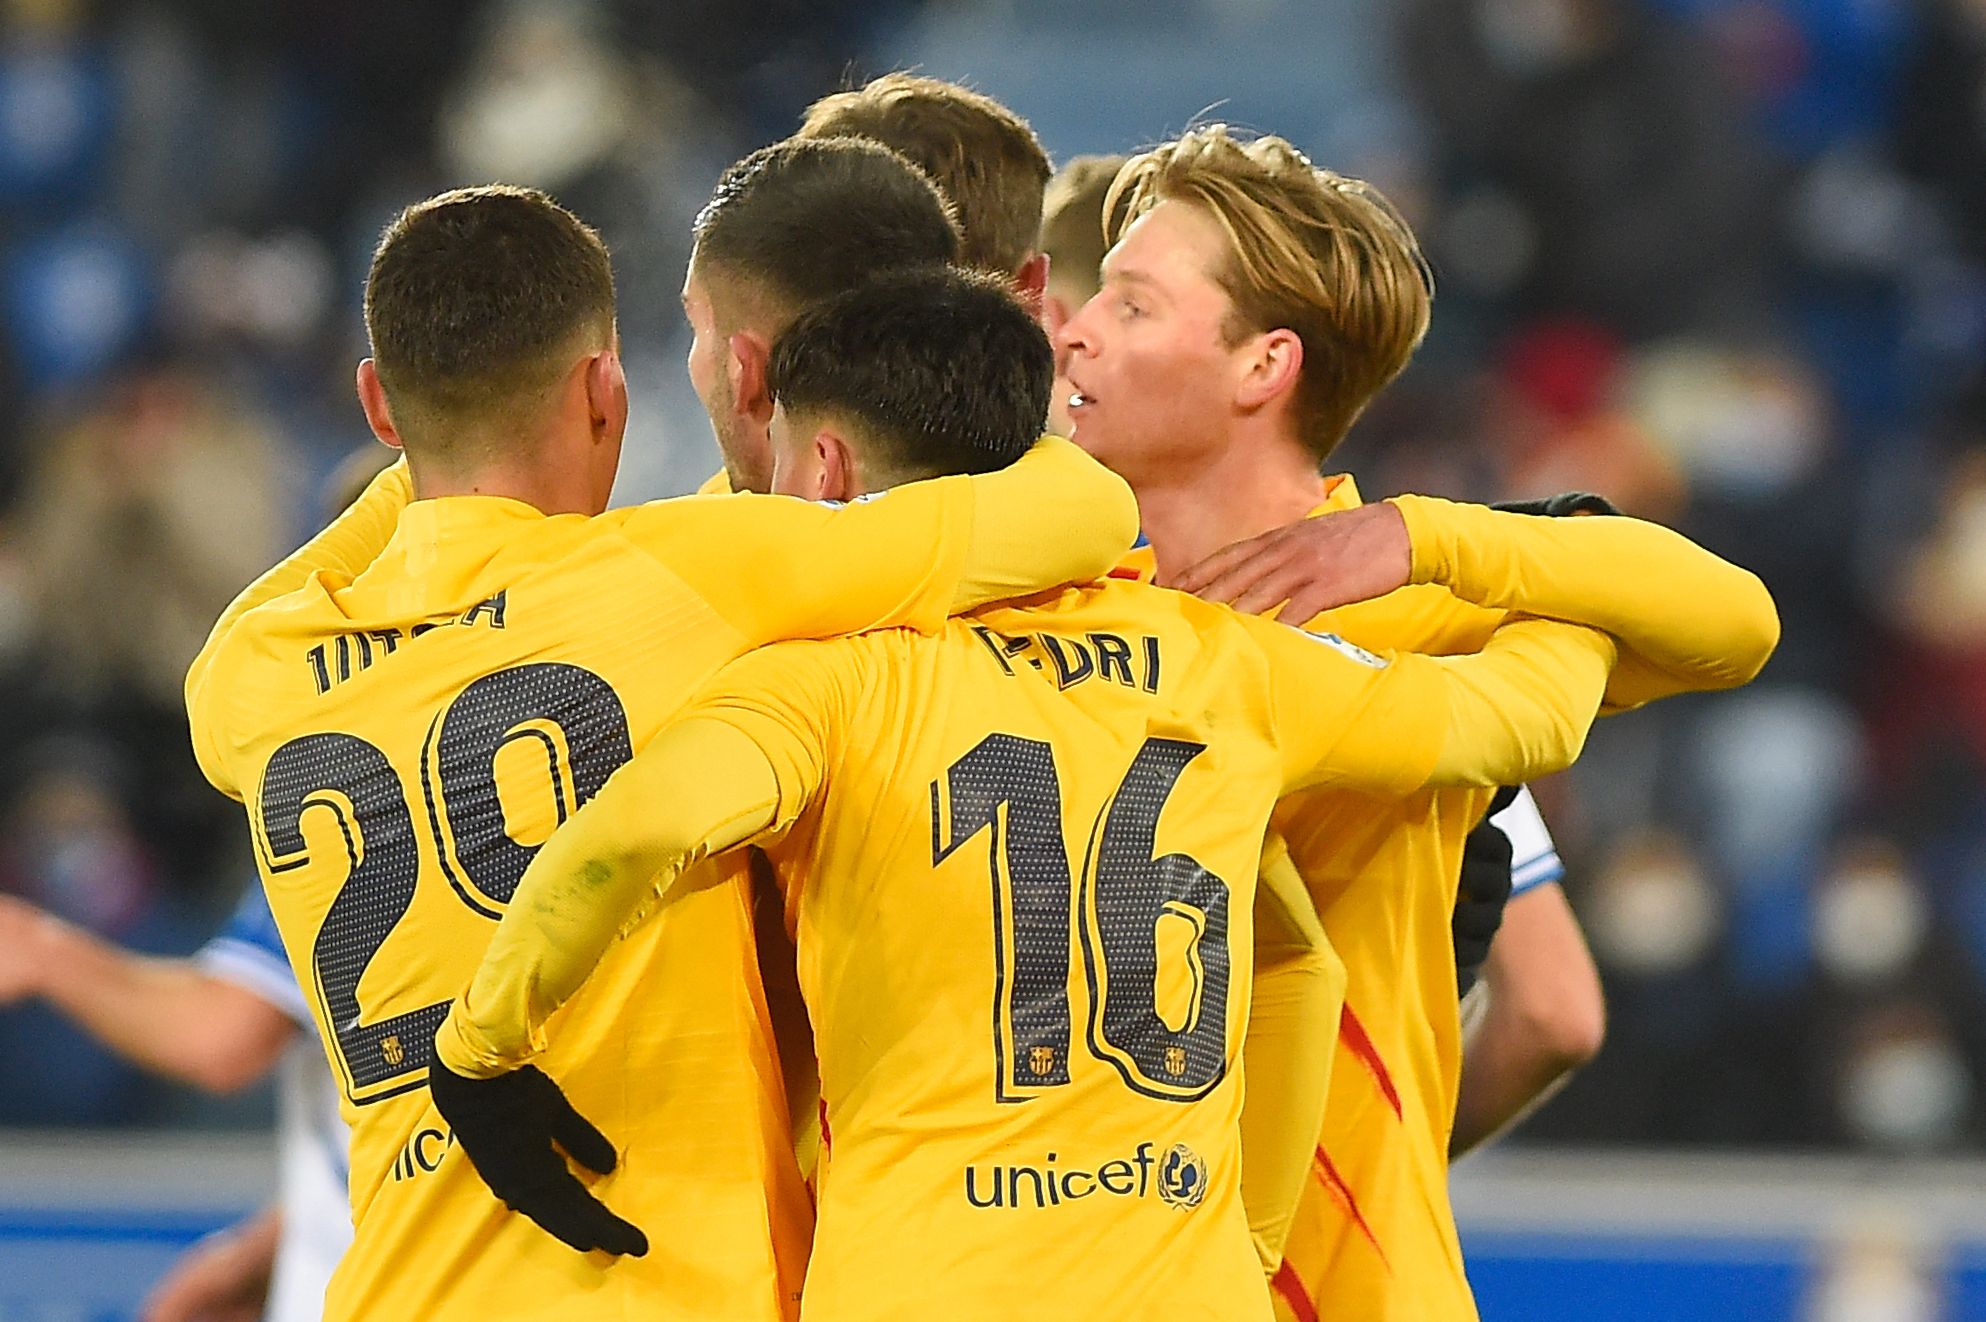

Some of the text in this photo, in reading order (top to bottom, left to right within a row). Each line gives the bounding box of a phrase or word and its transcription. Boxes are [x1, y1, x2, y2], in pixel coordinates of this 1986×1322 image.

[255, 662, 633, 1107] 20
[930, 733, 1230, 1103] 16
[966, 1142, 1156, 1208] unicef
